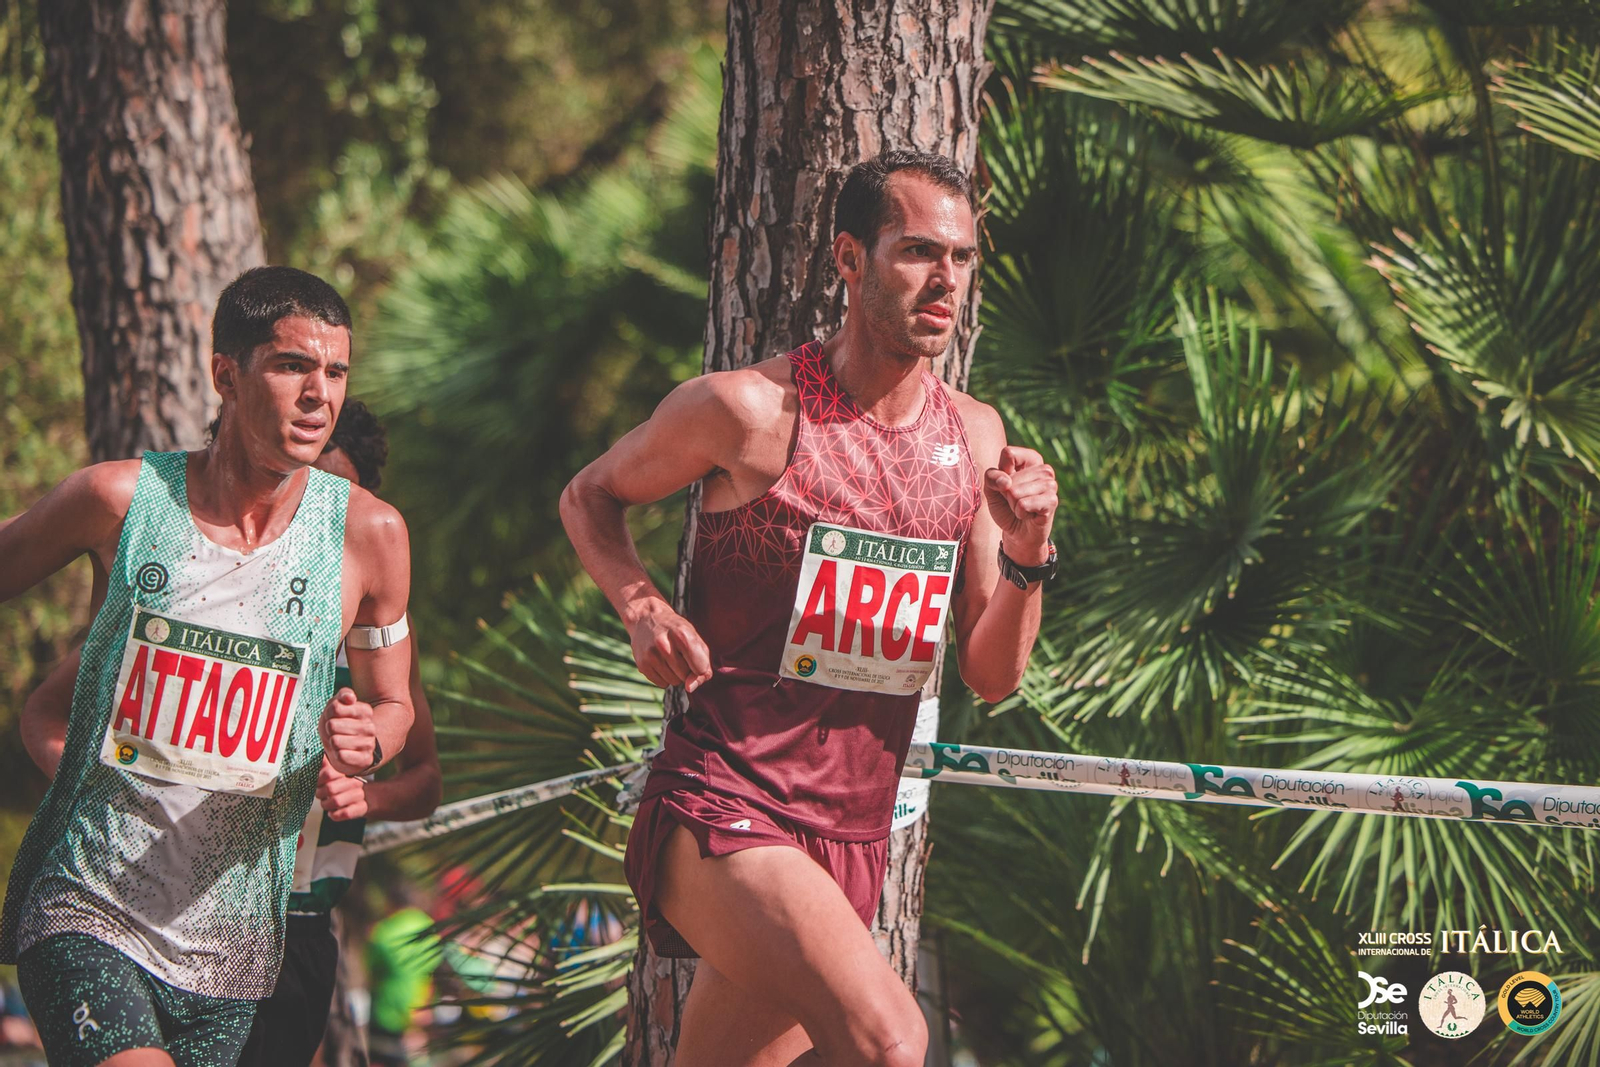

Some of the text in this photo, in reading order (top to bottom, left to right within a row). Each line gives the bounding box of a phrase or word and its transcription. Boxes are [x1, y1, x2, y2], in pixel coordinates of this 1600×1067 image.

[855, 556, 893, 566] INTERNATIONAL
[856, 540, 926, 565] ITÁLICA
[790, 559, 950, 662] ARCE
[179, 645, 219, 657] INTERNATIONAL
[180, 628, 261, 660] ITÁLICA
[113, 644, 298, 764] ATTAOUI
[997, 750, 1075, 771] Diputación
[1261, 775, 1345, 796] Diputación
